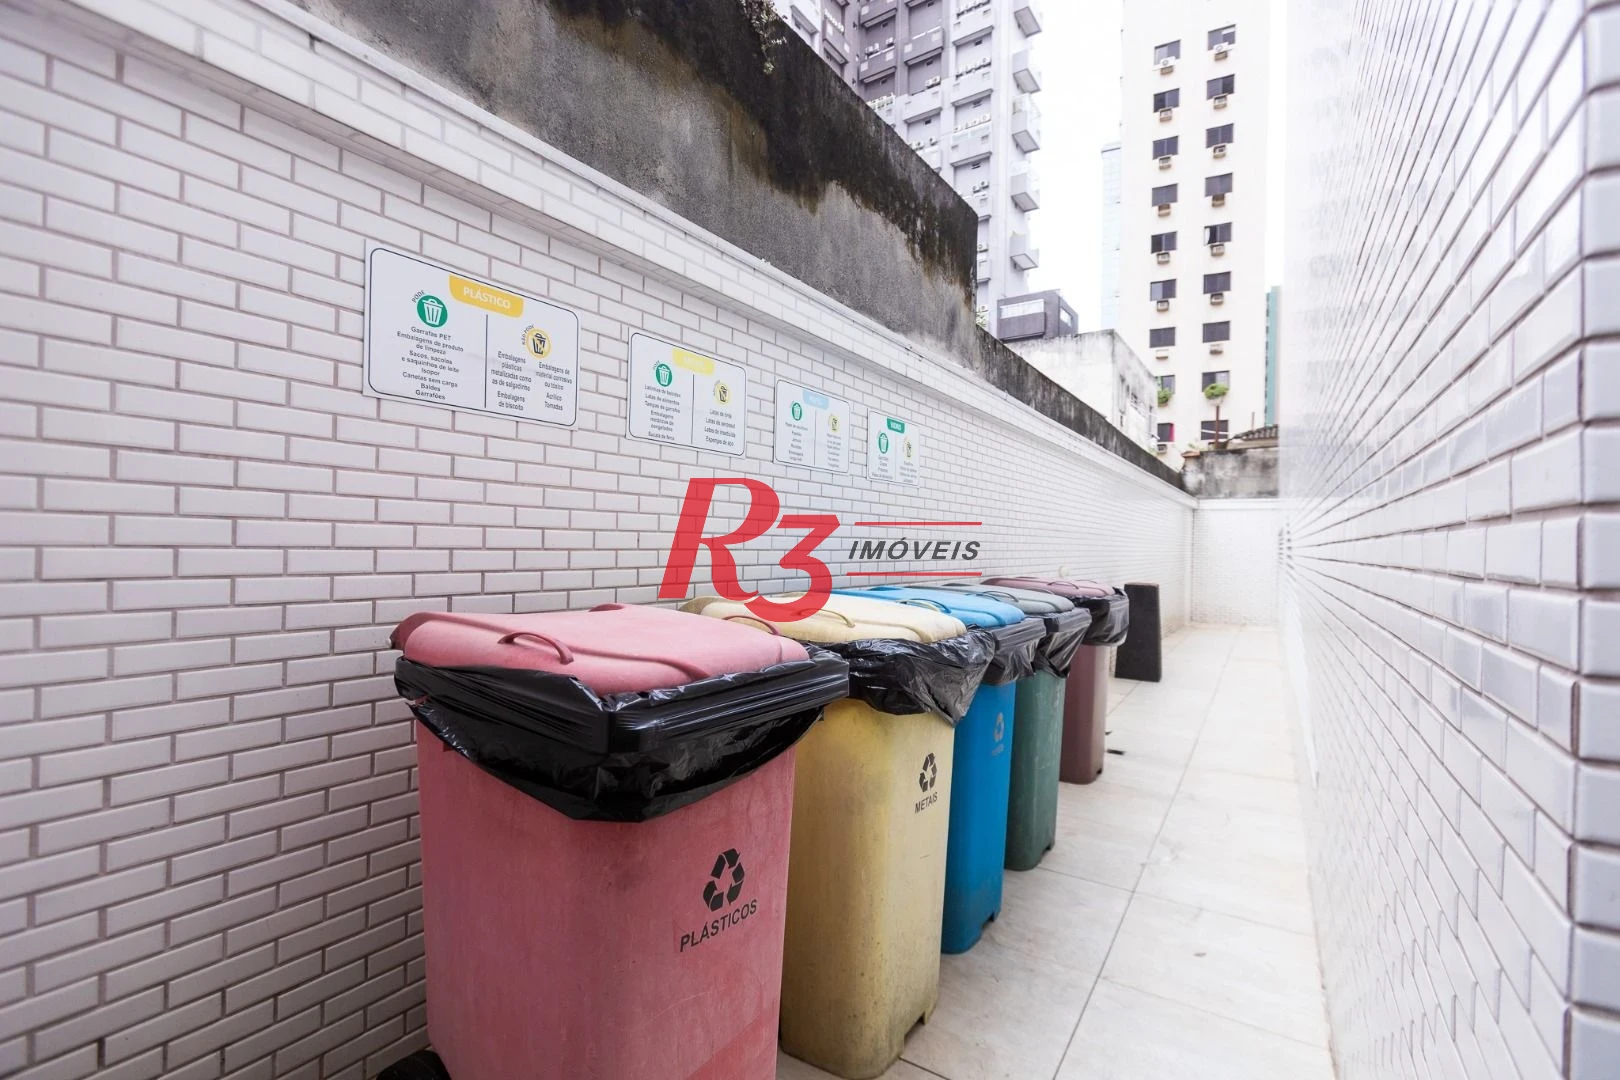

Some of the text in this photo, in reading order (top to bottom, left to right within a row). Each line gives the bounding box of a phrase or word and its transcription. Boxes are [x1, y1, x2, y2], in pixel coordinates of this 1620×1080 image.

[412, 290, 425, 303] PODE
[463, 286, 511, 309] PLÁSTICO
[397, 331, 432, 345] Embalagens
[411, 326, 452, 341] Garrafas PET
[425, 345, 446, 355] limpeza
[406, 357, 438, 369] saquinhos
[431, 356, 453, 365] sacolas
[498, 351, 526, 364] Embalagens
[421, 368, 440, 376] Isopor
[539, 362, 564, 374] Embalagens
[402, 372, 427, 381] Canetas
[442, 380, 458, 388] carga
[421, 383, 440, 392] Baldes
[416, 389, 446, 400] Garrafões
[497, 391, 525, 403] Embalagens
[914, 792, 938, 814] METAIS
[679, 899, 758, 953] PLÁSTICOS
